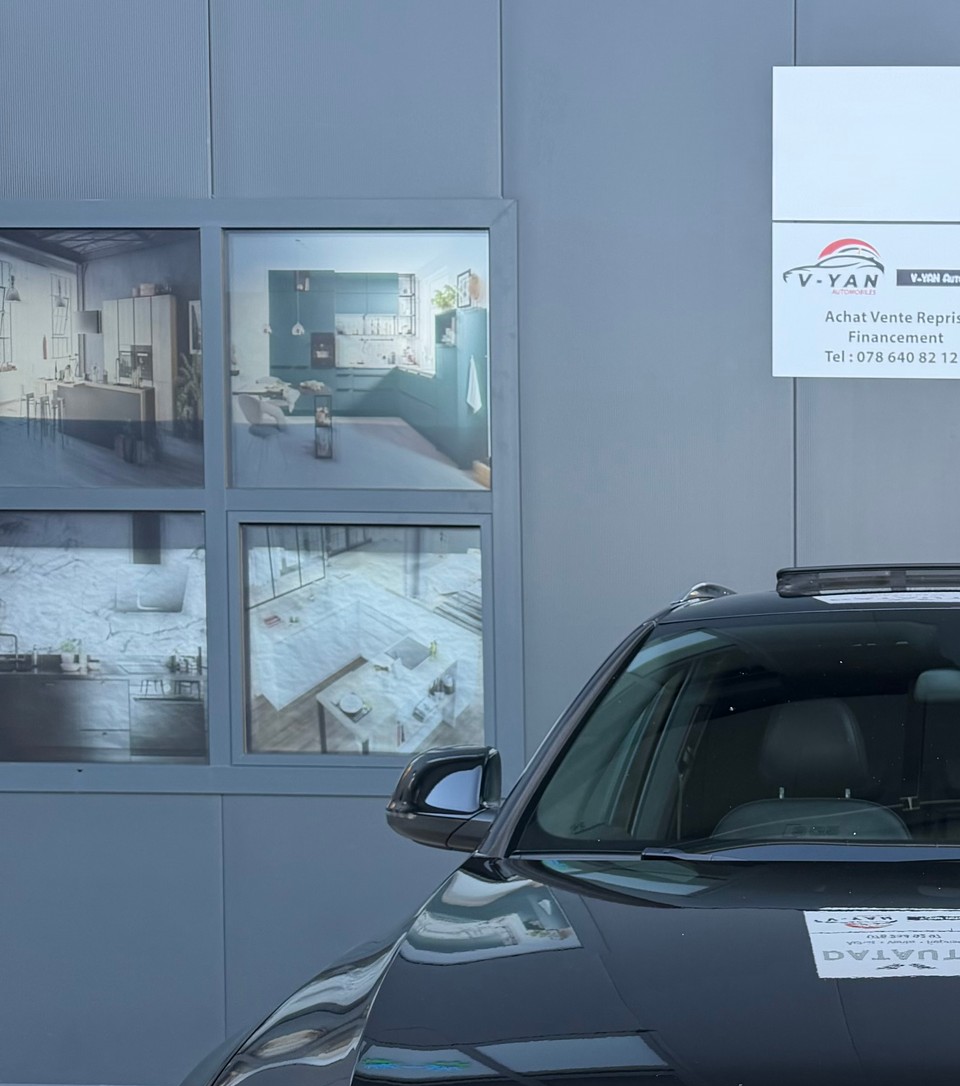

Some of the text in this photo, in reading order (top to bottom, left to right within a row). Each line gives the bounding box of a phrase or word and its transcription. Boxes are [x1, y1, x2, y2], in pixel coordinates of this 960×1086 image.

[798, 273, 879, 288] V-YAN
[910, 273, 941, 283] V-YAN
[825, 310, 867, 323] Achat
[871, 311, 913, 324] Vente
[848, 331, 944, 344] Financement
[825, 350, 845, 363] Tel
[856, 351, 884, 364] 078
[888, 351, 915, 364] 640
[918, 351, 936, 364] 82
[942, 351, 958, 364] 12
